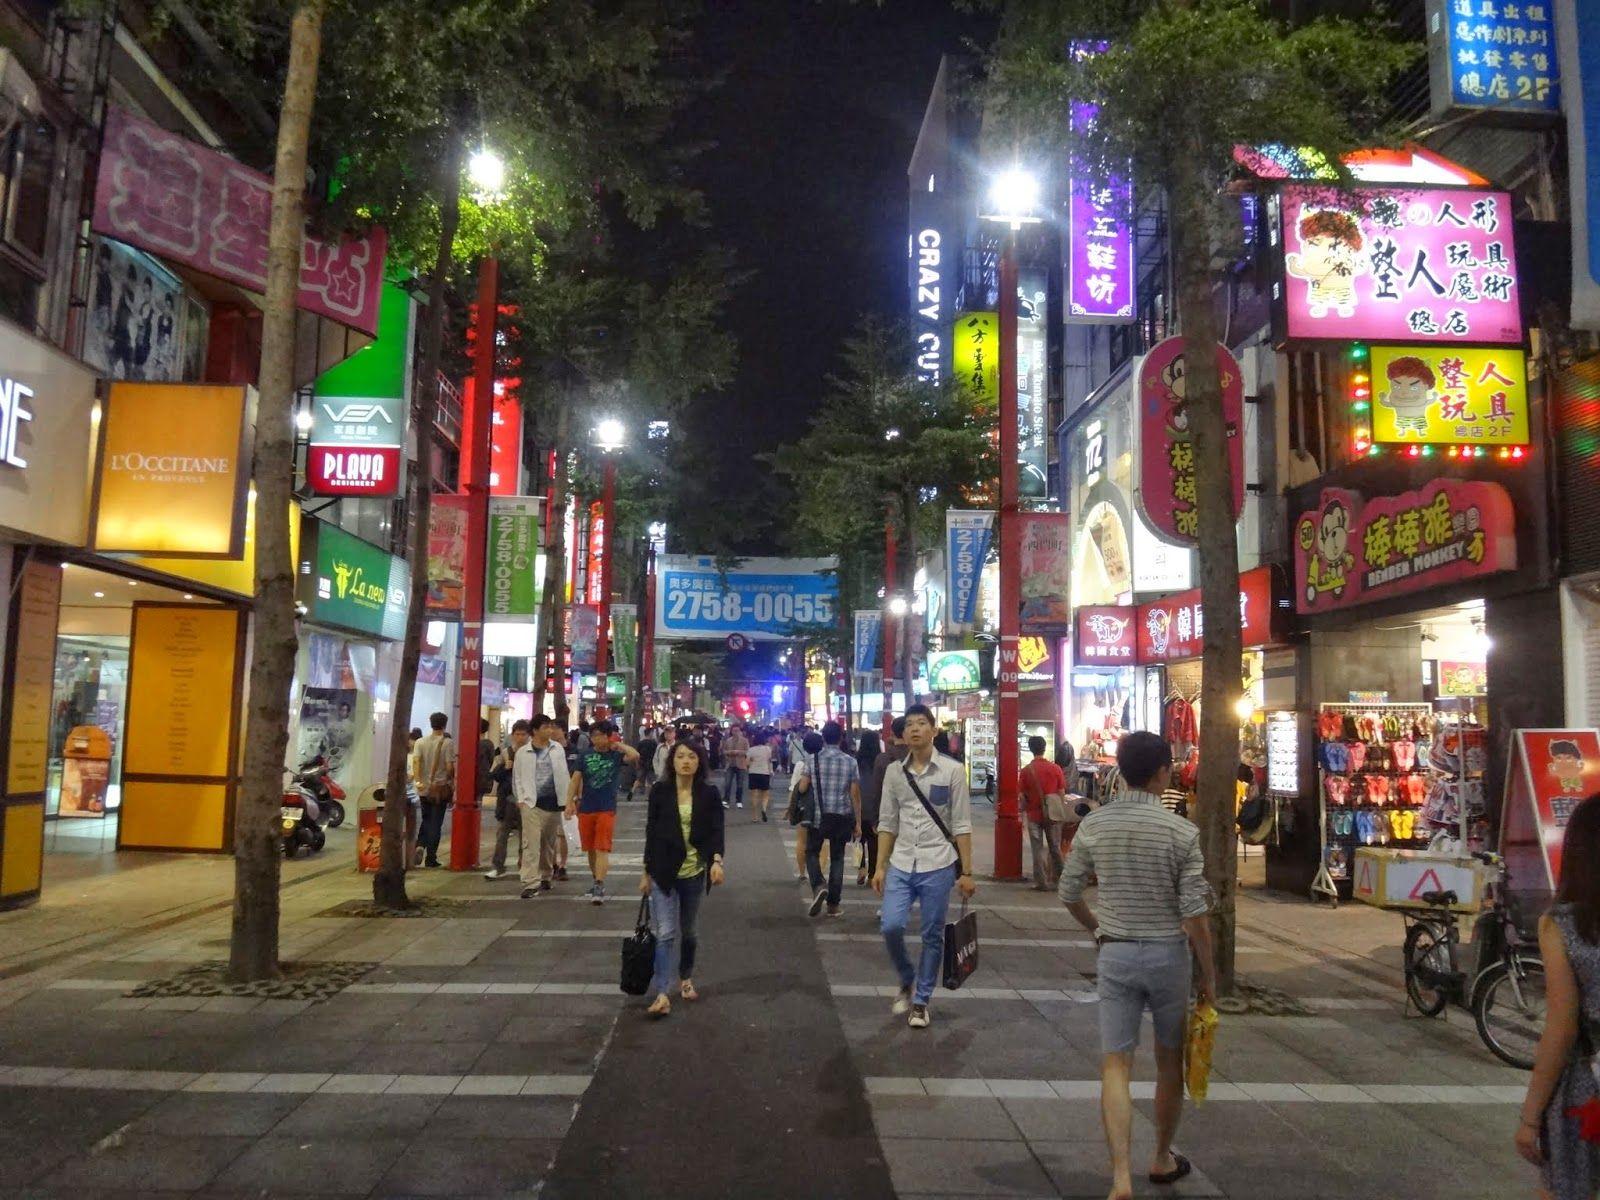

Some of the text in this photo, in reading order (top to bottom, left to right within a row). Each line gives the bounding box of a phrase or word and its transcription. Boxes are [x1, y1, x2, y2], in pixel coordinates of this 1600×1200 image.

[1369, 238, 1446, 300] 整人
[1447, 243, 1508, 269] 玩具
[918, 229, 941, 321] CRAZY
[1448, 271, 1512, 301] 魔術
[1409, 310, 1469, 335] 總店
[1437, 357, 1516, 389] 整人
[1439, 392, 1516, 424] 玩具
[1033, 416, 1045, 448] Steak
[111, 452, 229, 473] L'OCCITANE
[323, 452, 385, 481] PLAYA
[1413, 541, 1465, 572] MONKEY
[349, 567, 365, 597] La
[366, 585, 385, 604] new
[667, 590, 833, 623] 2758-0055
[464, 637, 480, 650] W
[1002, 650, 1017, 663] W
[463, 659, 479, 671] 10
[1001, 672, 1017, 683] 09
